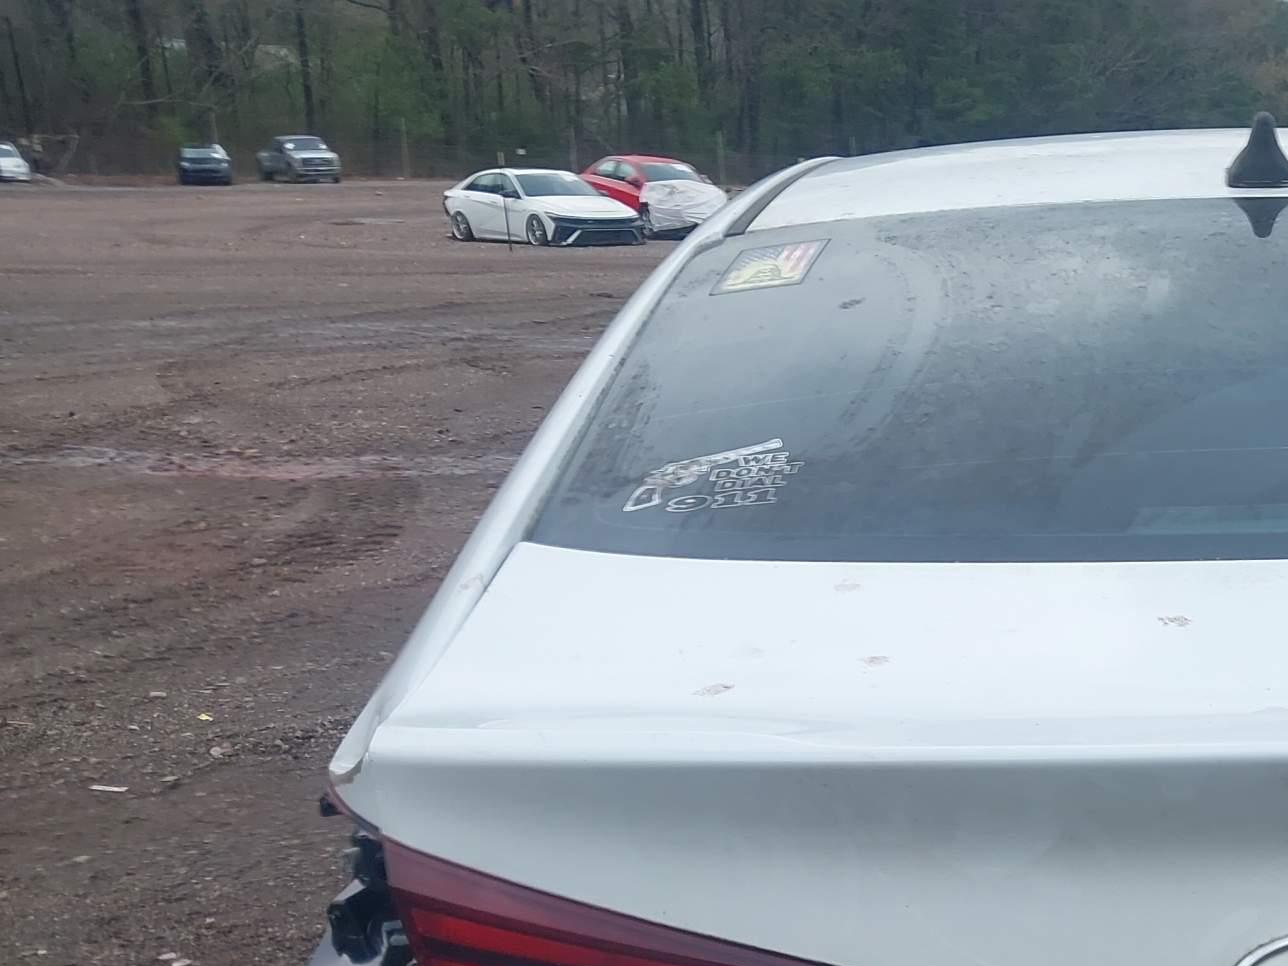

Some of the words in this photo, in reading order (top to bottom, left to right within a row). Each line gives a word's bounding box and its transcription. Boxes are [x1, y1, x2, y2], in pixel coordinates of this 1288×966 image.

[738, 451, 790, 467] WE
[714, 475, 787, 492] DIAL
[665, 488, 778, 512] 911
